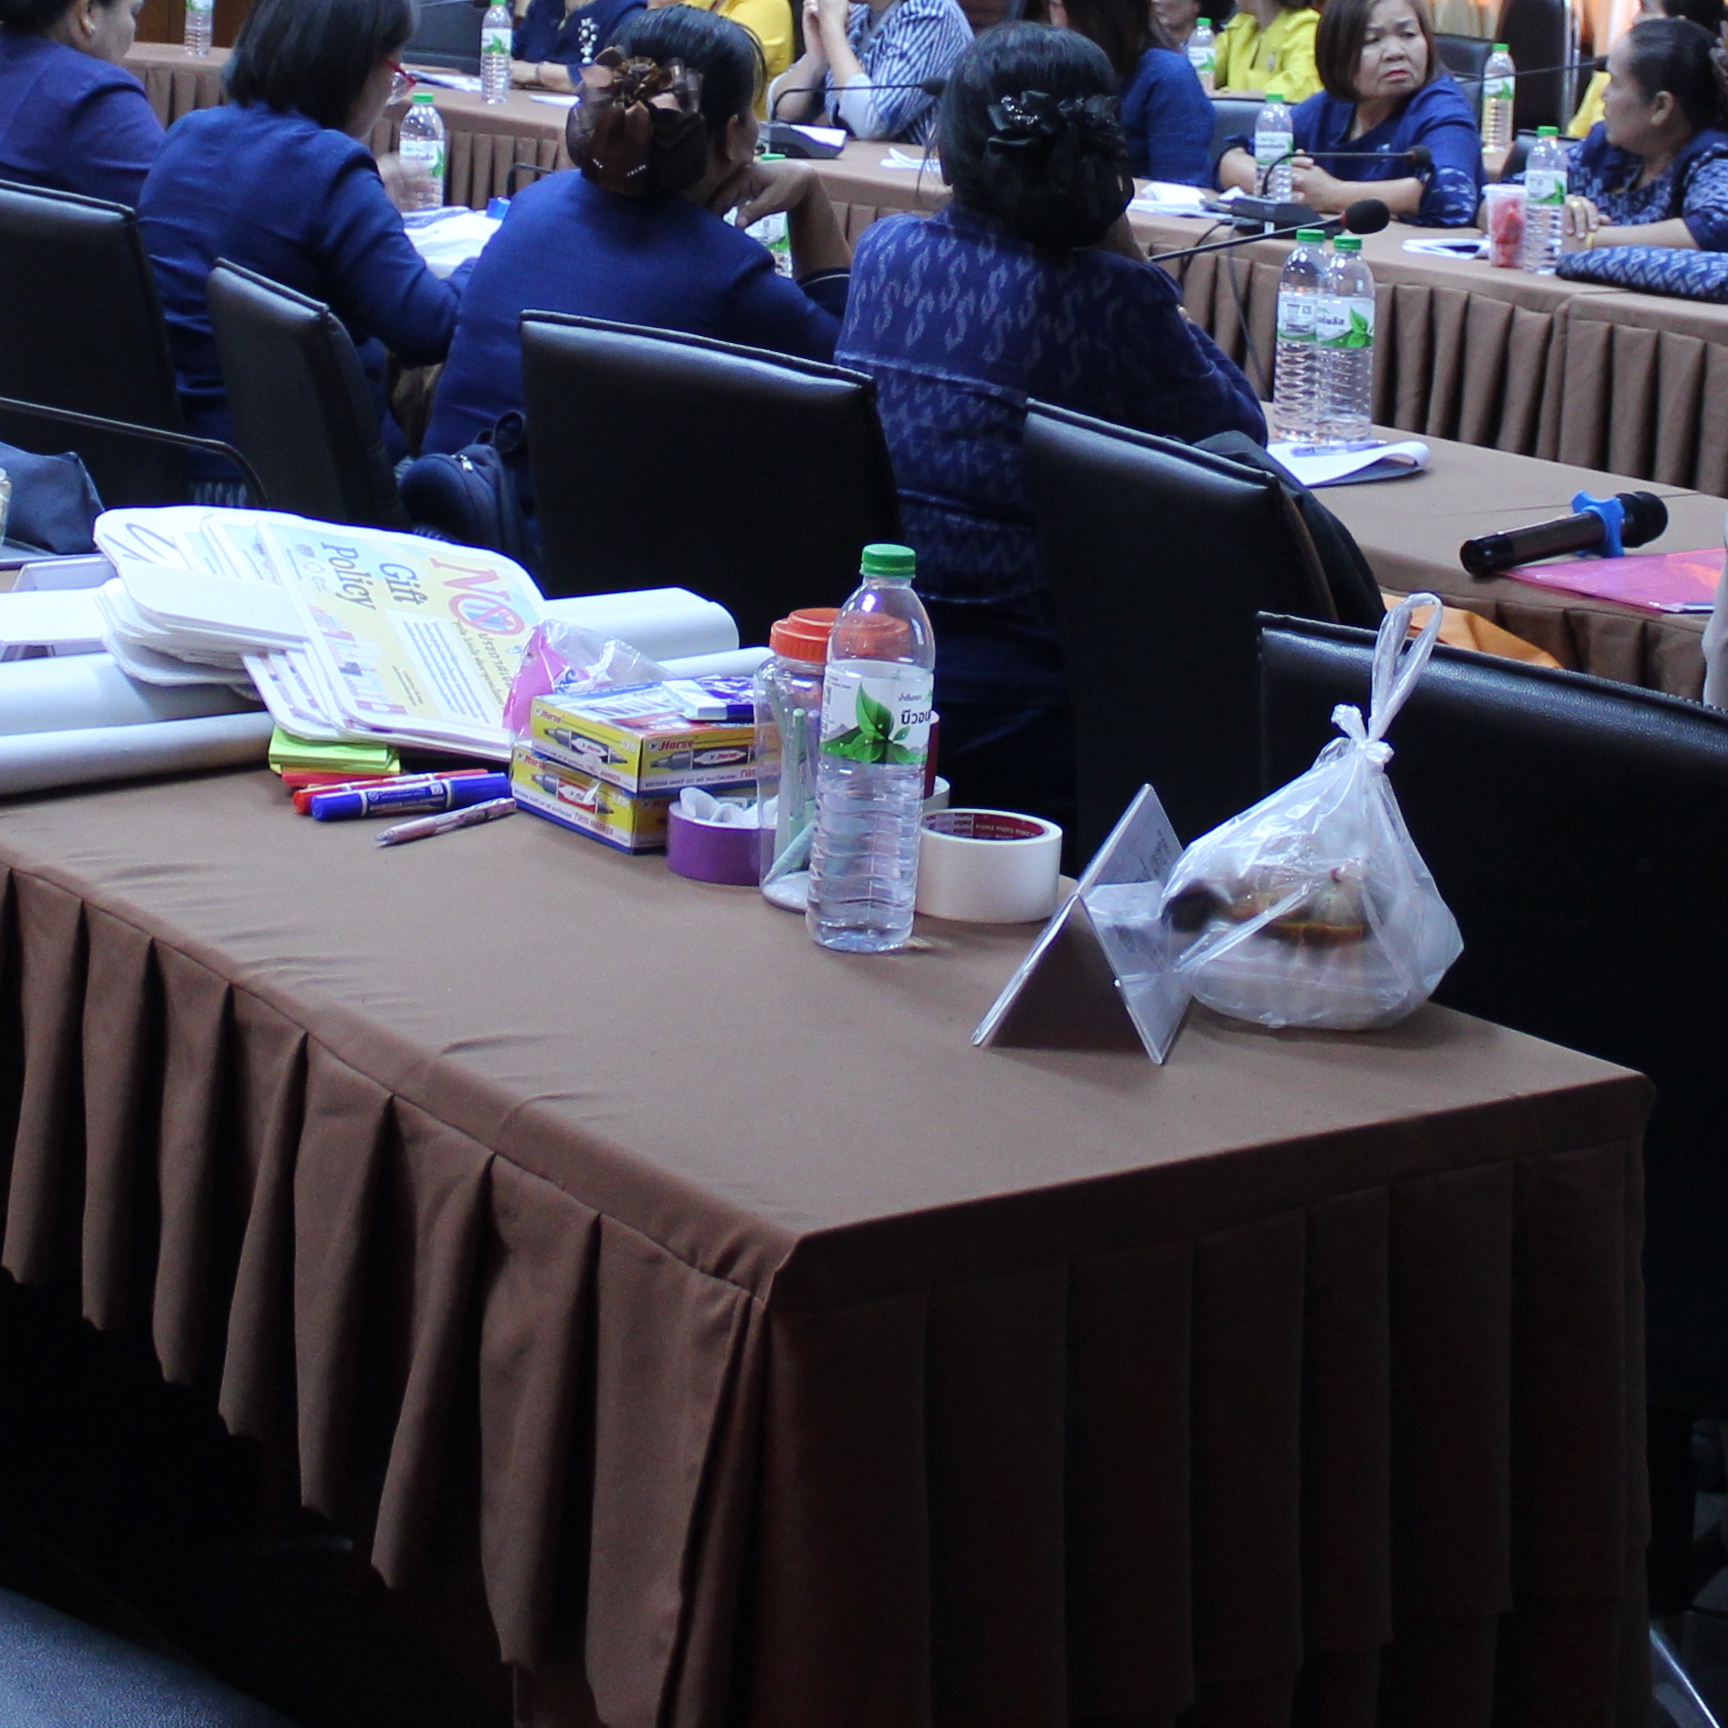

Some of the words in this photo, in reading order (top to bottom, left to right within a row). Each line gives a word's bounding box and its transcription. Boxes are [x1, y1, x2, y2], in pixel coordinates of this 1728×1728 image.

[320, 541, 377, 611] Policy
[379, 561, 428, 606] Gift
[541, 709, 562, 723] Horse
[659, 739, 695, 751] Horse
